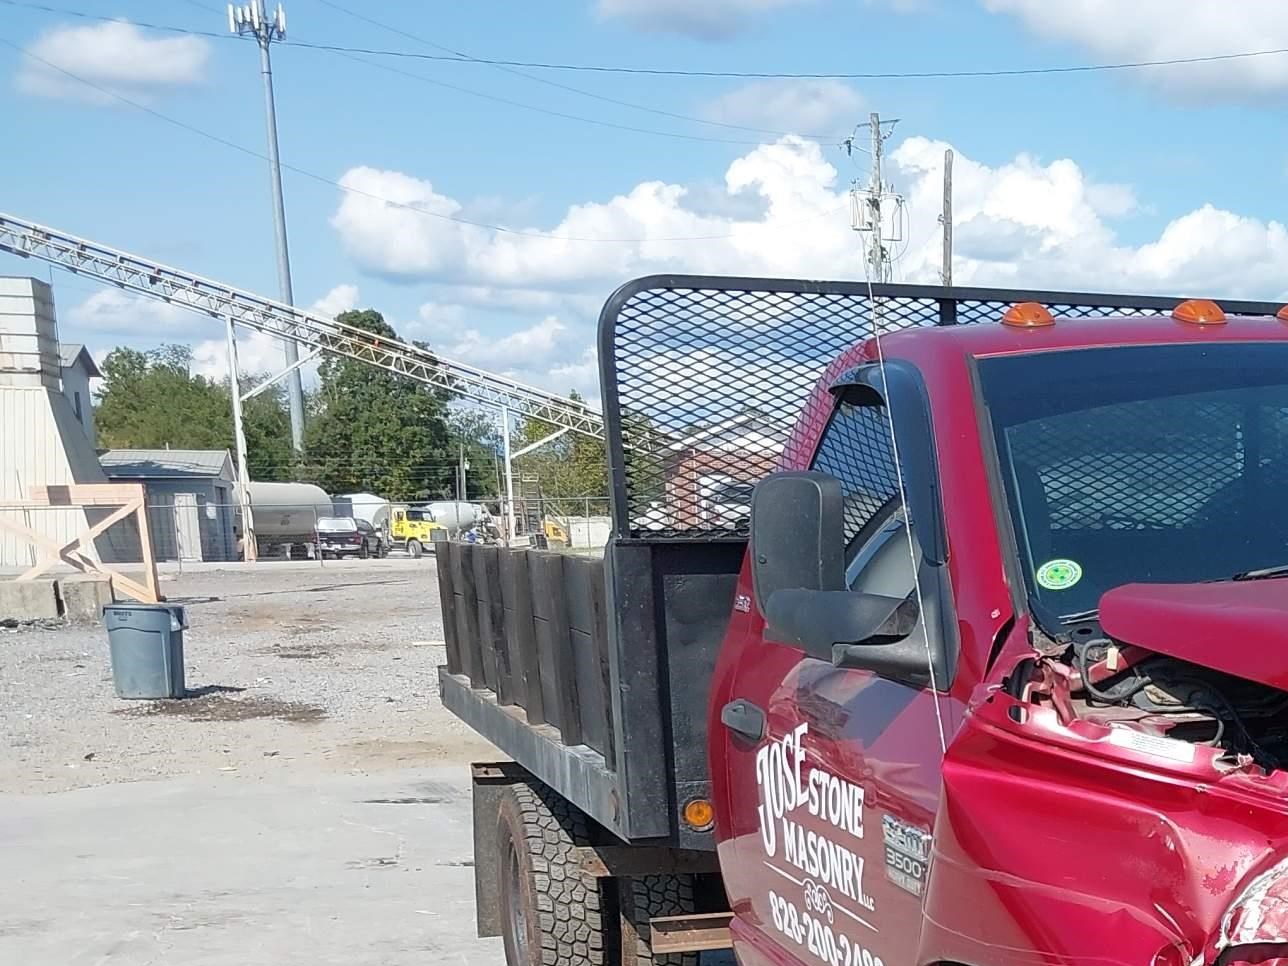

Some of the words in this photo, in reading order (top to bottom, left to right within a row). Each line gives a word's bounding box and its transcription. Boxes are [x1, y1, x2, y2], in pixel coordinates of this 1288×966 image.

[757, 723, 809, 857] JOSE
[810, 768, 864, 839] STONE
[783, 817, 865, 904] MASONRY
[886, 847, 922, 878] 3500
